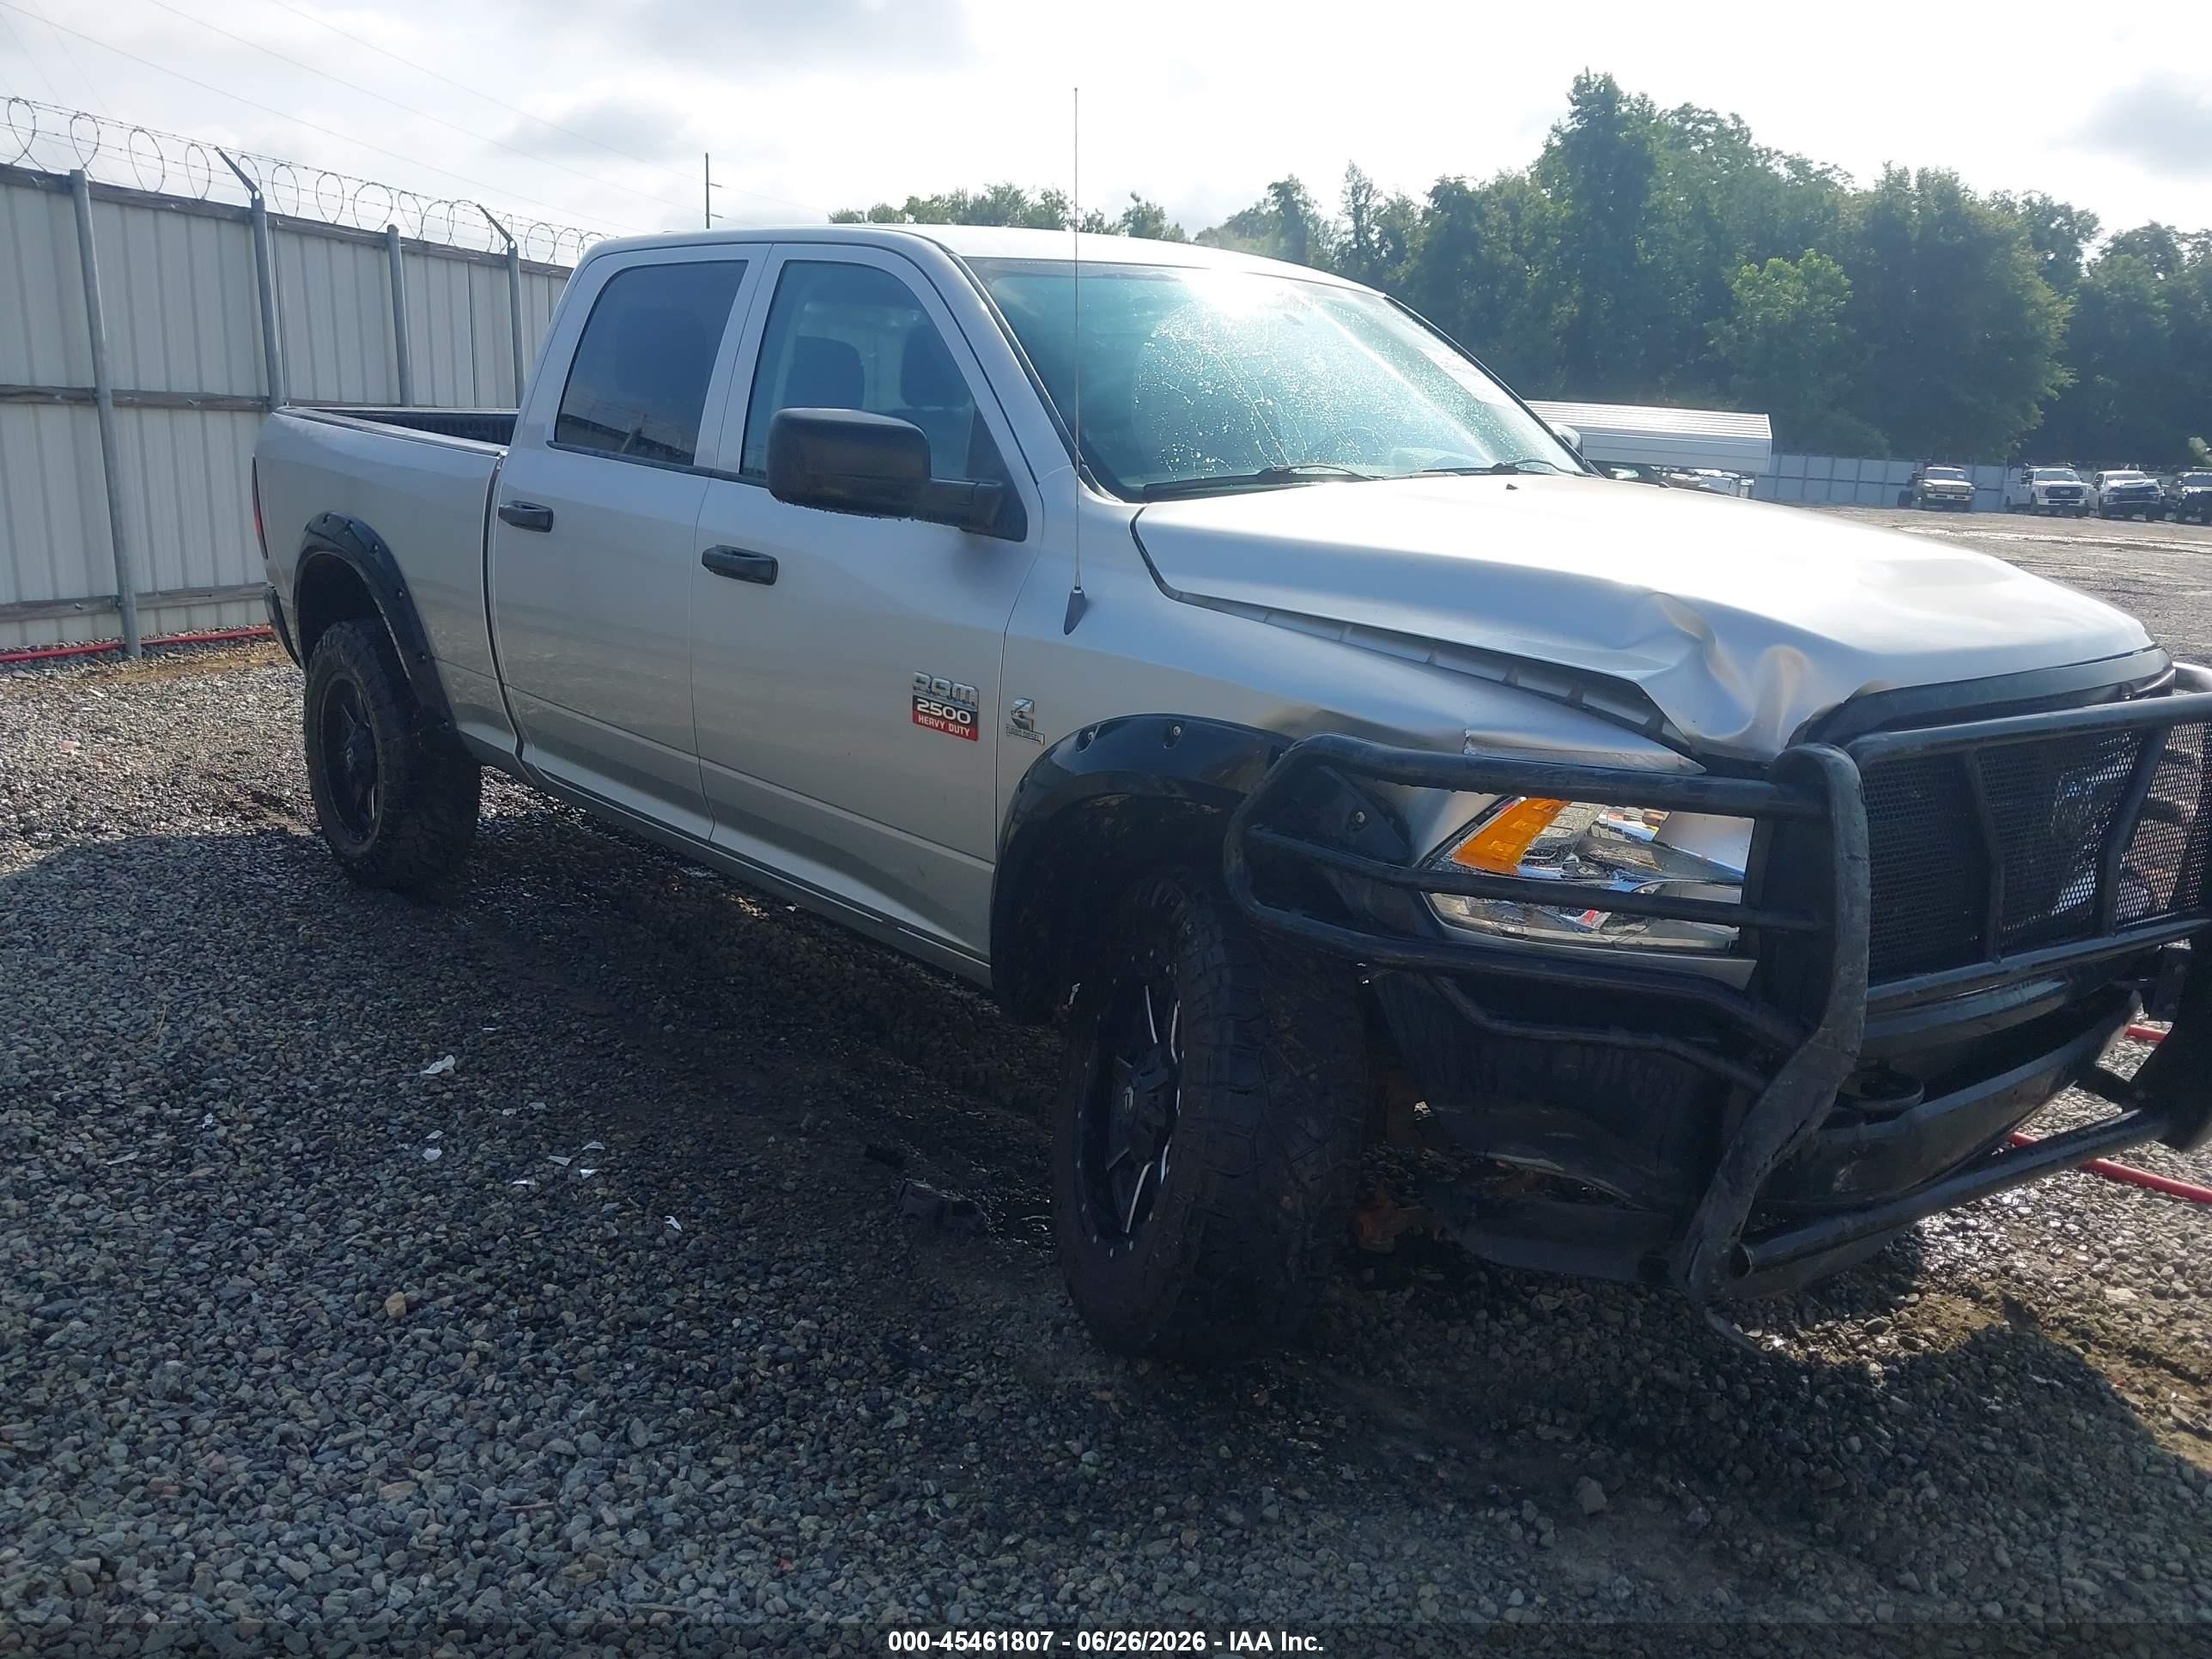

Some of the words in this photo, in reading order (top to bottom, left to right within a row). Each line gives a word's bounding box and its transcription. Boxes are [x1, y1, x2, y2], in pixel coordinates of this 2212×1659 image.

[913, 671, 979, 704] RAM
[917, 698, 972, 725] 2500
[919, 714, 945, 730] HEAVY
[949, 723, 970, 737] DUTY
